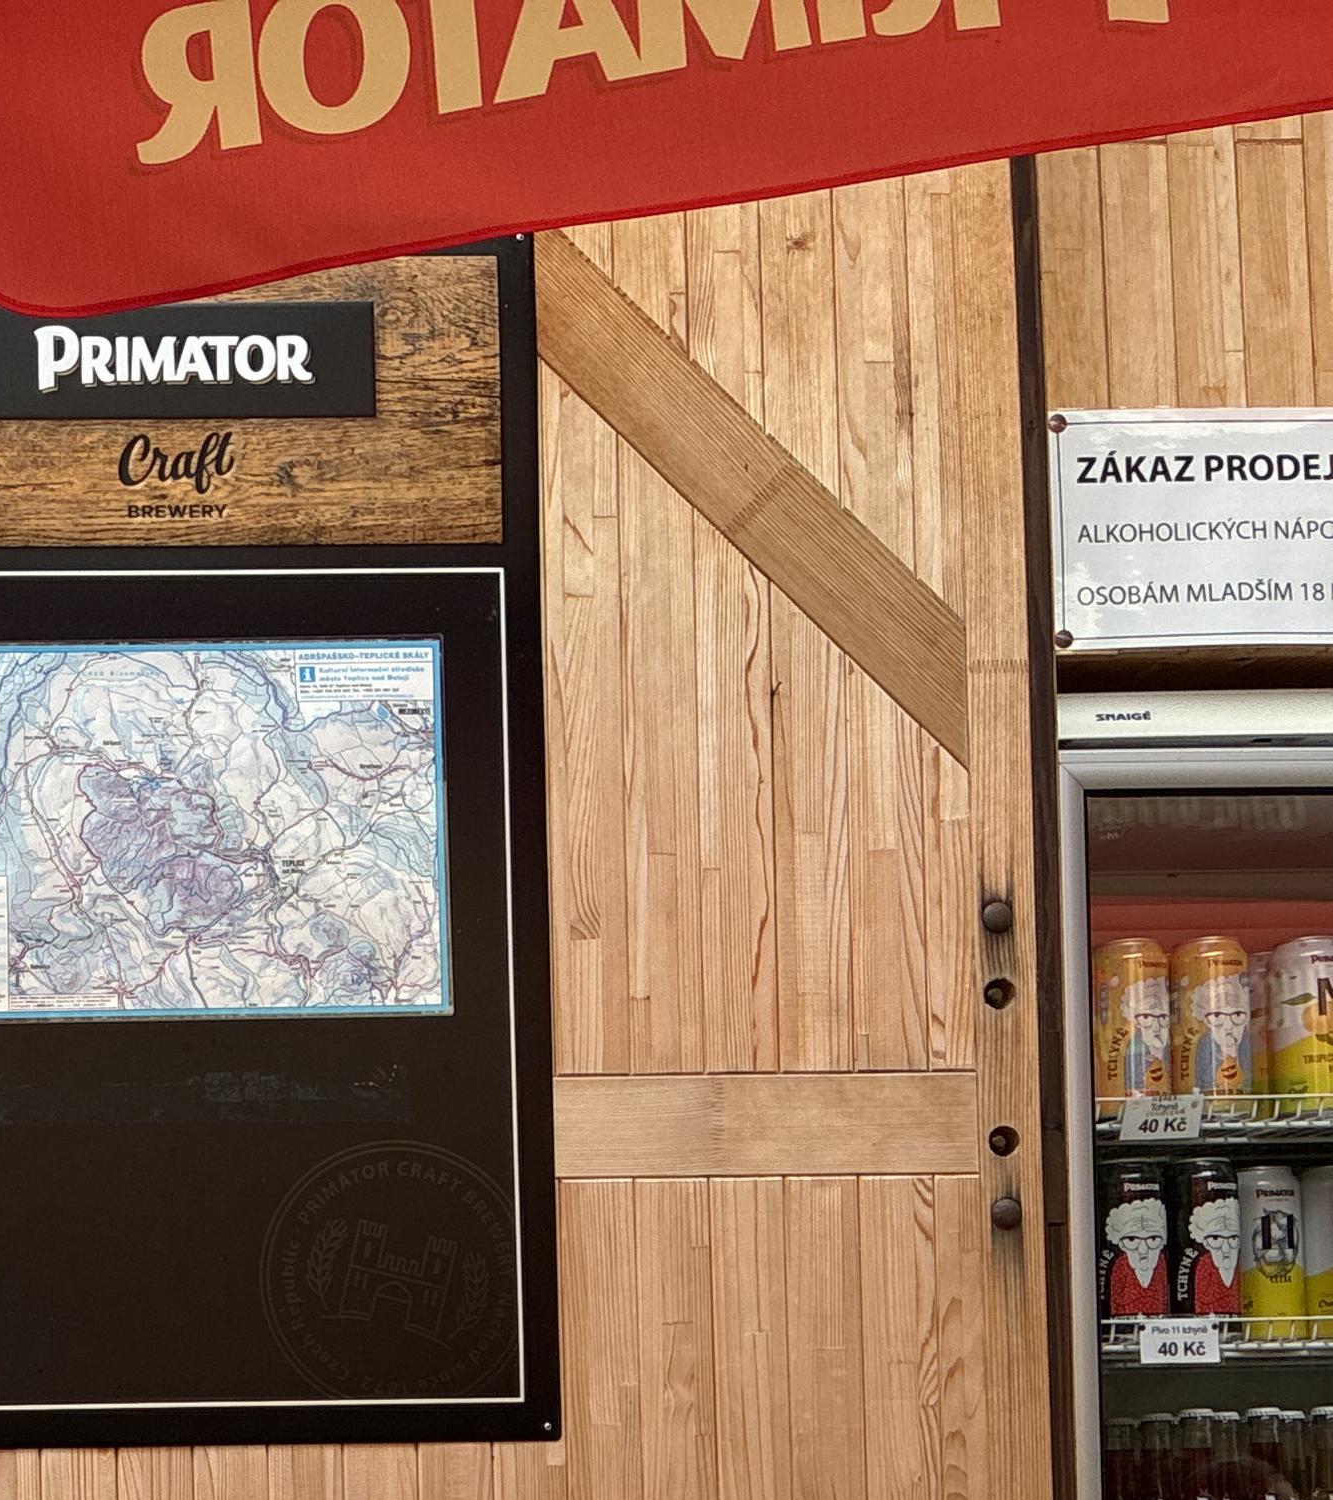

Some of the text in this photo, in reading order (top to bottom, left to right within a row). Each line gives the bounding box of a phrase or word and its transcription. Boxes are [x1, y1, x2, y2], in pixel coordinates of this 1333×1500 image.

[34, 325, 315, 393] PRIMATOR
[118, 432, 234, 494] Craft
[1077, 451, 1195, 483] ZÁKAZ
[127, 504, 228, 518] BREWERY
[1077, 517, 1267, 543] ALKOHOLICKÝCH
[1077, 582, 1179, 606] OSOBÁM
[1186, 578, 1293, 602] MLADŠÍM
[1300, 583, 1325, 601] 18
[1138, 1117, 1187, 1133] 40 Kč
[1157, 1341, 1206, 1357] 40 Kč
